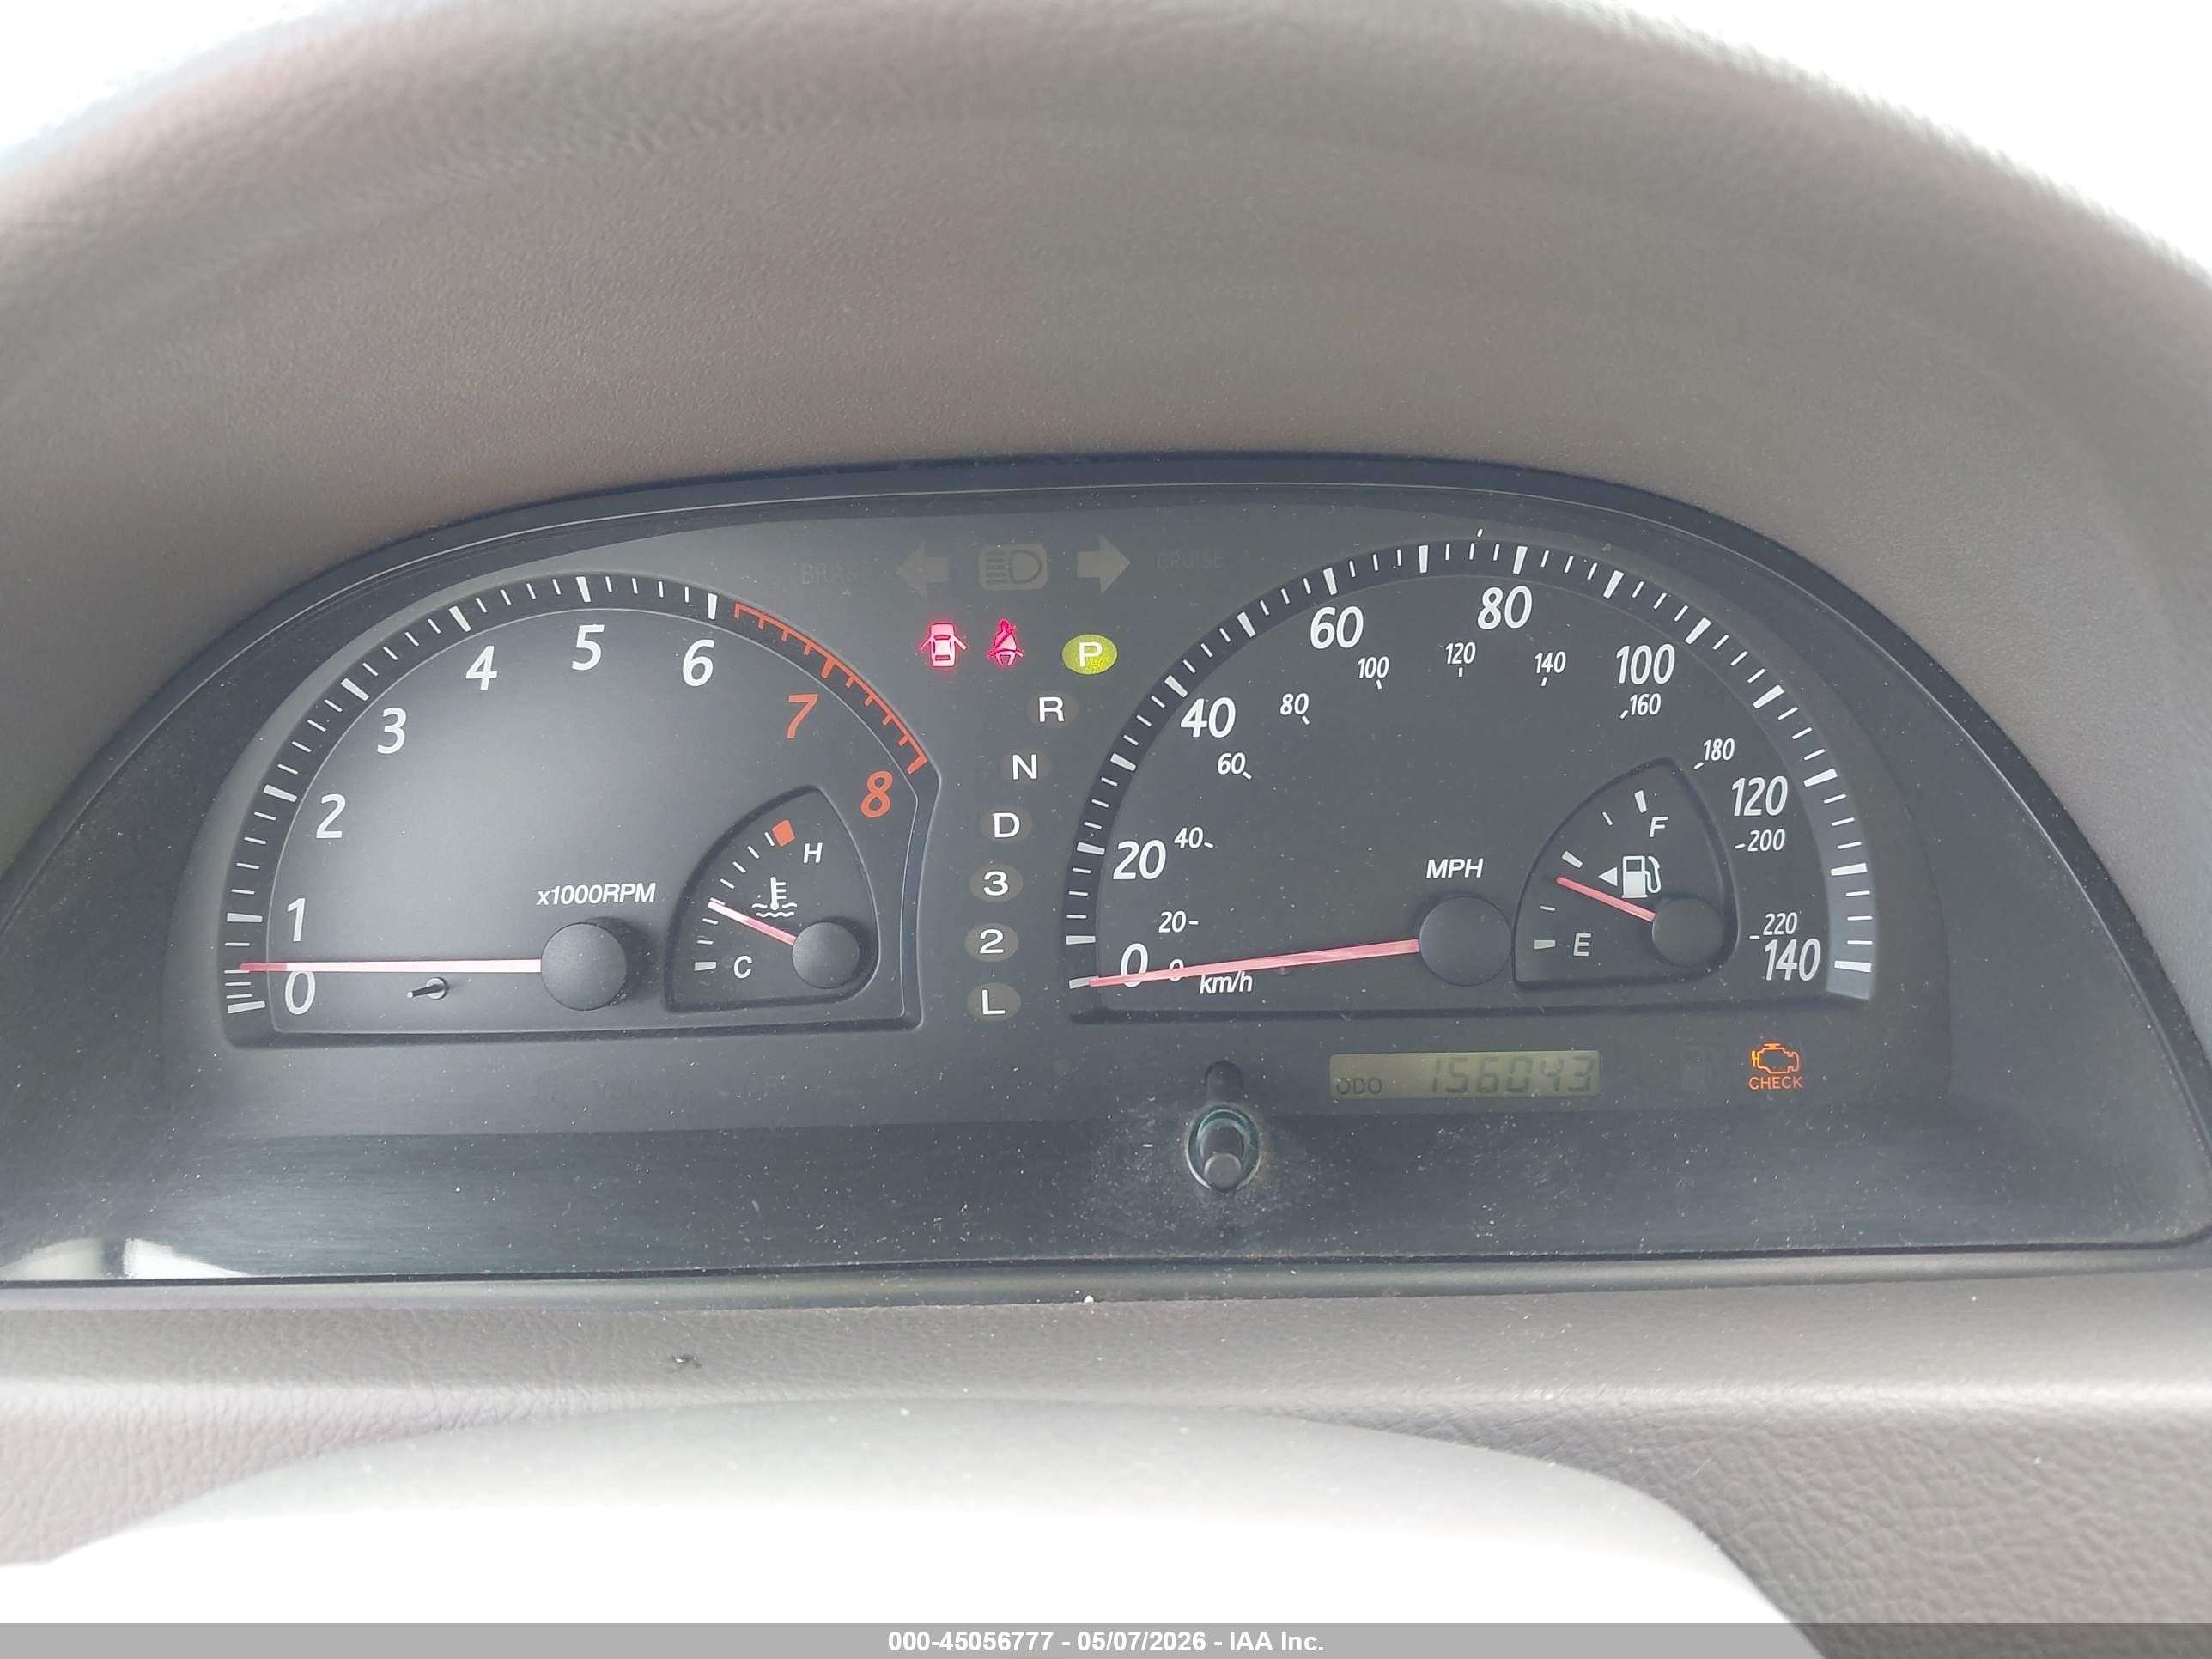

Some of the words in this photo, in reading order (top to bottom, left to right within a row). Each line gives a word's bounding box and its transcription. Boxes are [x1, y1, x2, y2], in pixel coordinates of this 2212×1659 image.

[1478, 586, 1533, 629] 80
[1310, 606, 1364, 648] 60
[572, 624, 605, 671] 5
[1078, 642, 1103, 667] P
[1445, 642, 1476, 665] 120
[466, 646, 498, 690] 4
[682, 640, 714, 687] 6
[1358, 656, 1389, 679] 100
[1534, 651, 1566, 674] 140
[1616, 644, 1675, 685] 100
[787, 694, 818, 739] 7
[1039, 697, 1066, 723] R
[1279, 693, 1310, 715] 80
[1630, 694, 1662, 715] 160
[1181, 697, 1237, 738] 40
[377, 708, 407, 755] 3
[1703, 738, 1735, 761] 180
[1012, 754, 1038, 780] N
[1217, 752, 1246, 775] 60
[860, 771, 893, 817] 8
[1731, 776, 1789, 817] 120
[316, 793, 346, 839] 2
[994, 812, 1020, 838] D
[1649, 816, 1668, 838] F
[1175, 827, 1203, 848] 40
[1747, 829, 1786, 852] 200
[803, 842, 823, 864] H
[1113, 840, 1166, 880] 20
[1426, 858, 1484, 879] MPH
[536, 882, 657, 906] x1000RPM
[983, 871, 1009, 896] 3
[287, 898, 306, 942] 1
[1158, 910, 1187, 933] 20
[1762, 912, 1798, 936] 220
[980, 928, 1005, 954] 2
[1573, 933, 1592, 957] E
[733, 955, 753, 979] C
[1121, 943, 1149, 988] 0
[1763, 938, 1821, 981] 140
[284, 970, 316, 1015] 0
[1200, 970, 1254, 994] km/h
[981, 989, 1006, 1015] L
[1336, 1078, 1382, 1095] ODO
[1431, 1056, 1595, 1094] 156043
[1748, 1076, 1803, 1091] CHECK
